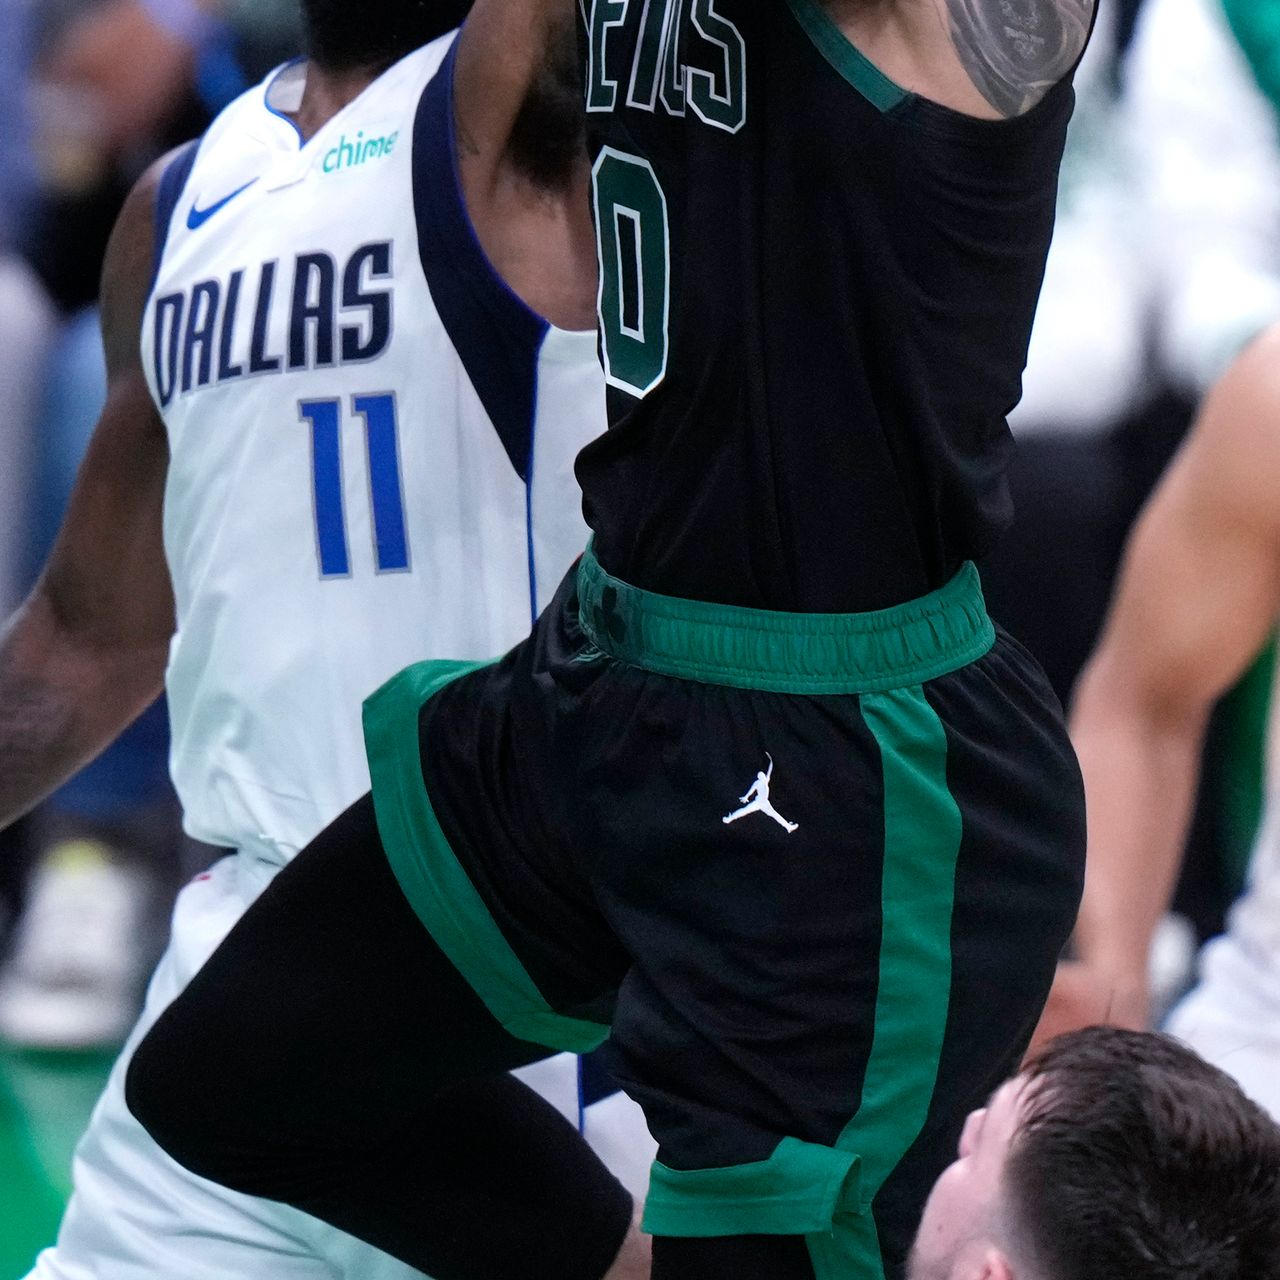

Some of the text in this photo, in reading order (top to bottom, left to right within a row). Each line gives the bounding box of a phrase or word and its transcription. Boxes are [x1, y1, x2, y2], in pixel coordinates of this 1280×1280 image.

[322, 131, 399, 173] chime
[154, 238, 394, 412] DALLAS
[591, 144, 671, 400] 0
[297, 390, 413, 580] 11
